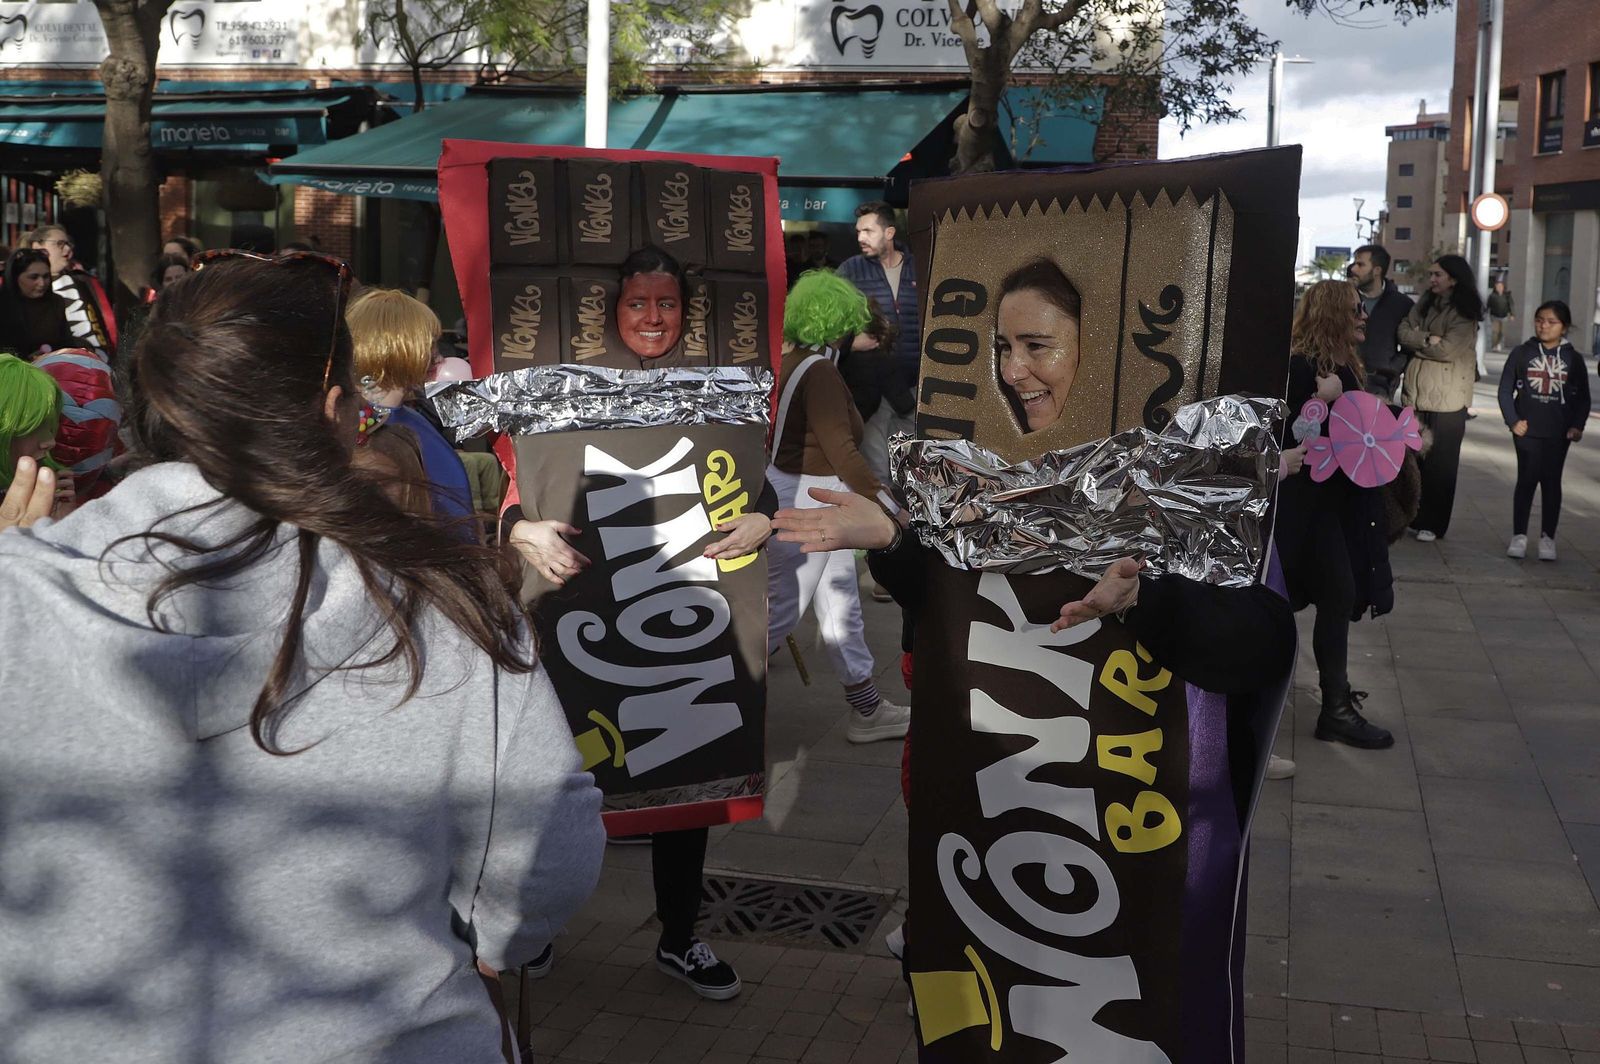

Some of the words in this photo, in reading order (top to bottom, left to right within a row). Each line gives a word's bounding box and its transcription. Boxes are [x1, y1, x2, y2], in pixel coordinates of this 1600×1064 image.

[896, 8, 952, 27] COLV
[904, 32, 926, 47] Dr.
[931, 32, 984, 47] Vicee
[161, 123, 231, 141] marieta
[402, 184, 438, 194] terraz
[804, 198, 827, 210] bar
[917, 278, 988, 442] GOLD
[1098, 640, 1182, 854] BAR
